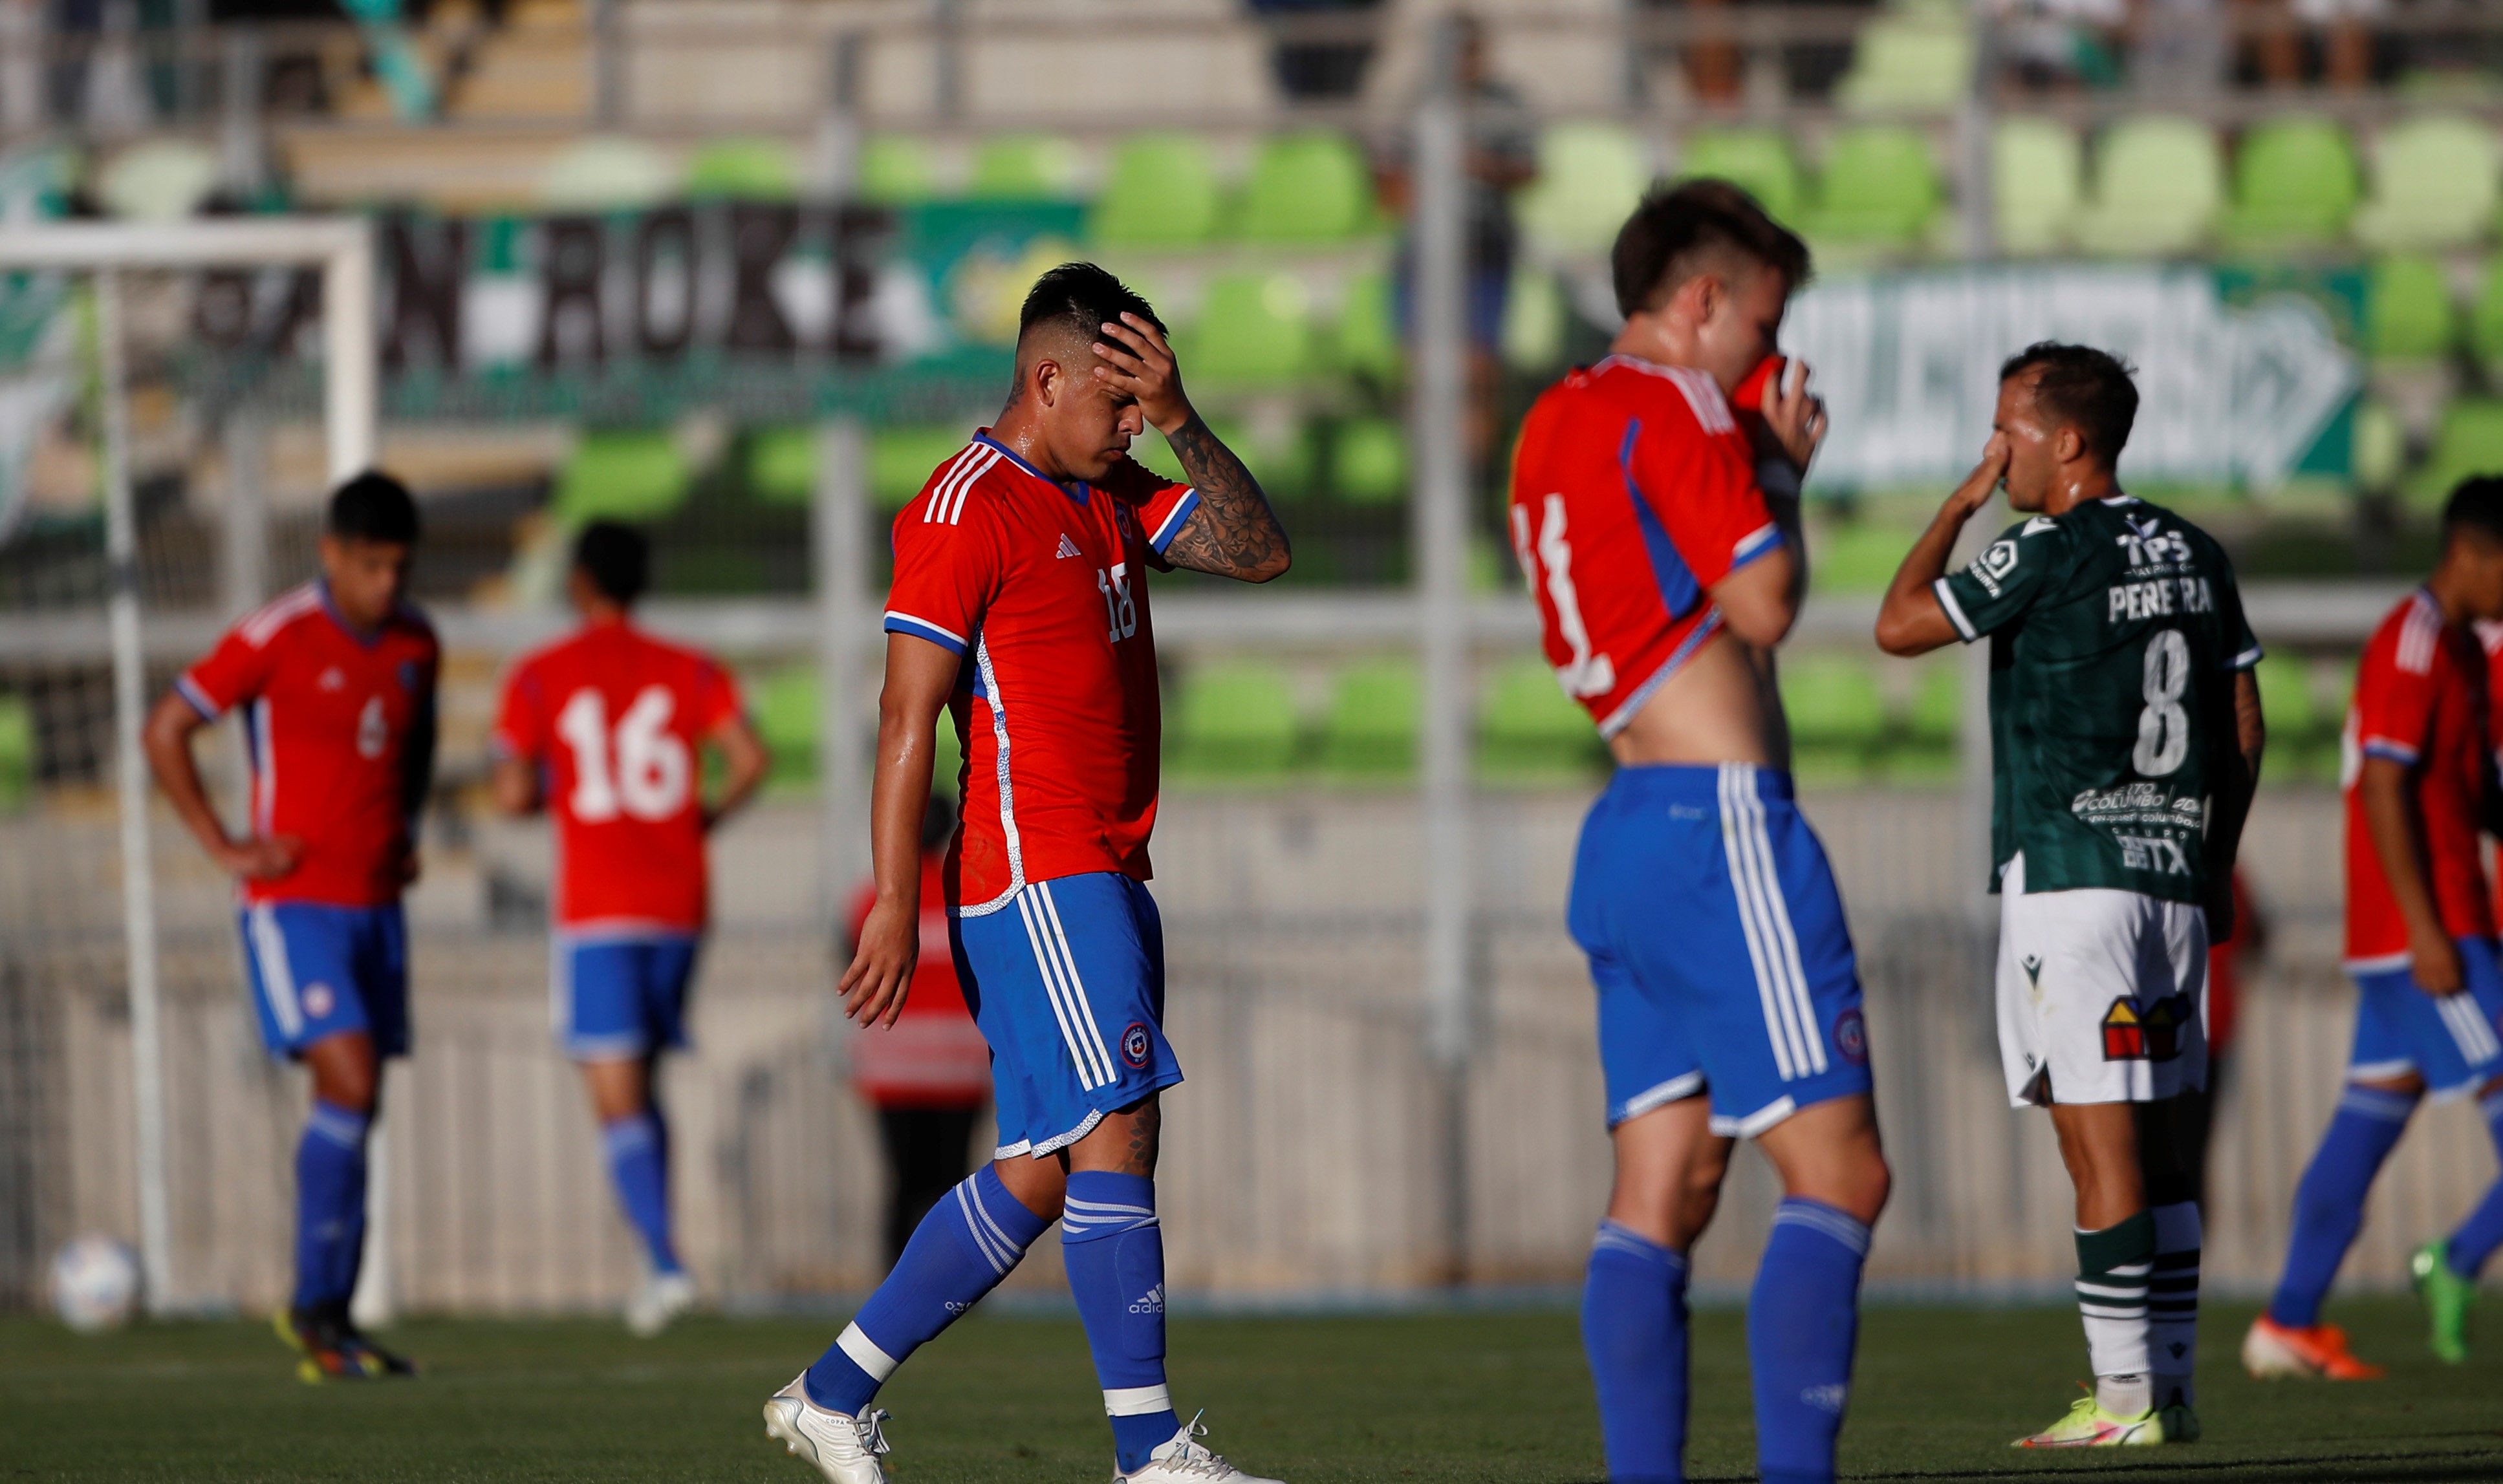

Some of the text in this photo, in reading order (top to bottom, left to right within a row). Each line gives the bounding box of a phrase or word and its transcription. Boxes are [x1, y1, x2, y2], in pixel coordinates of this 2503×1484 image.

[2116, 530, 2193, 566] TPS
[1097, 562, 1136, 643] 18
[2108, 577, 2213, 623] PERERA
[2132, 629, 2190, 777] 8
[557, 685, 689, 822] 16
[2087, 795, 2164, 811] COLUMBO
[1129, 1302, 1163, 1313] adid
